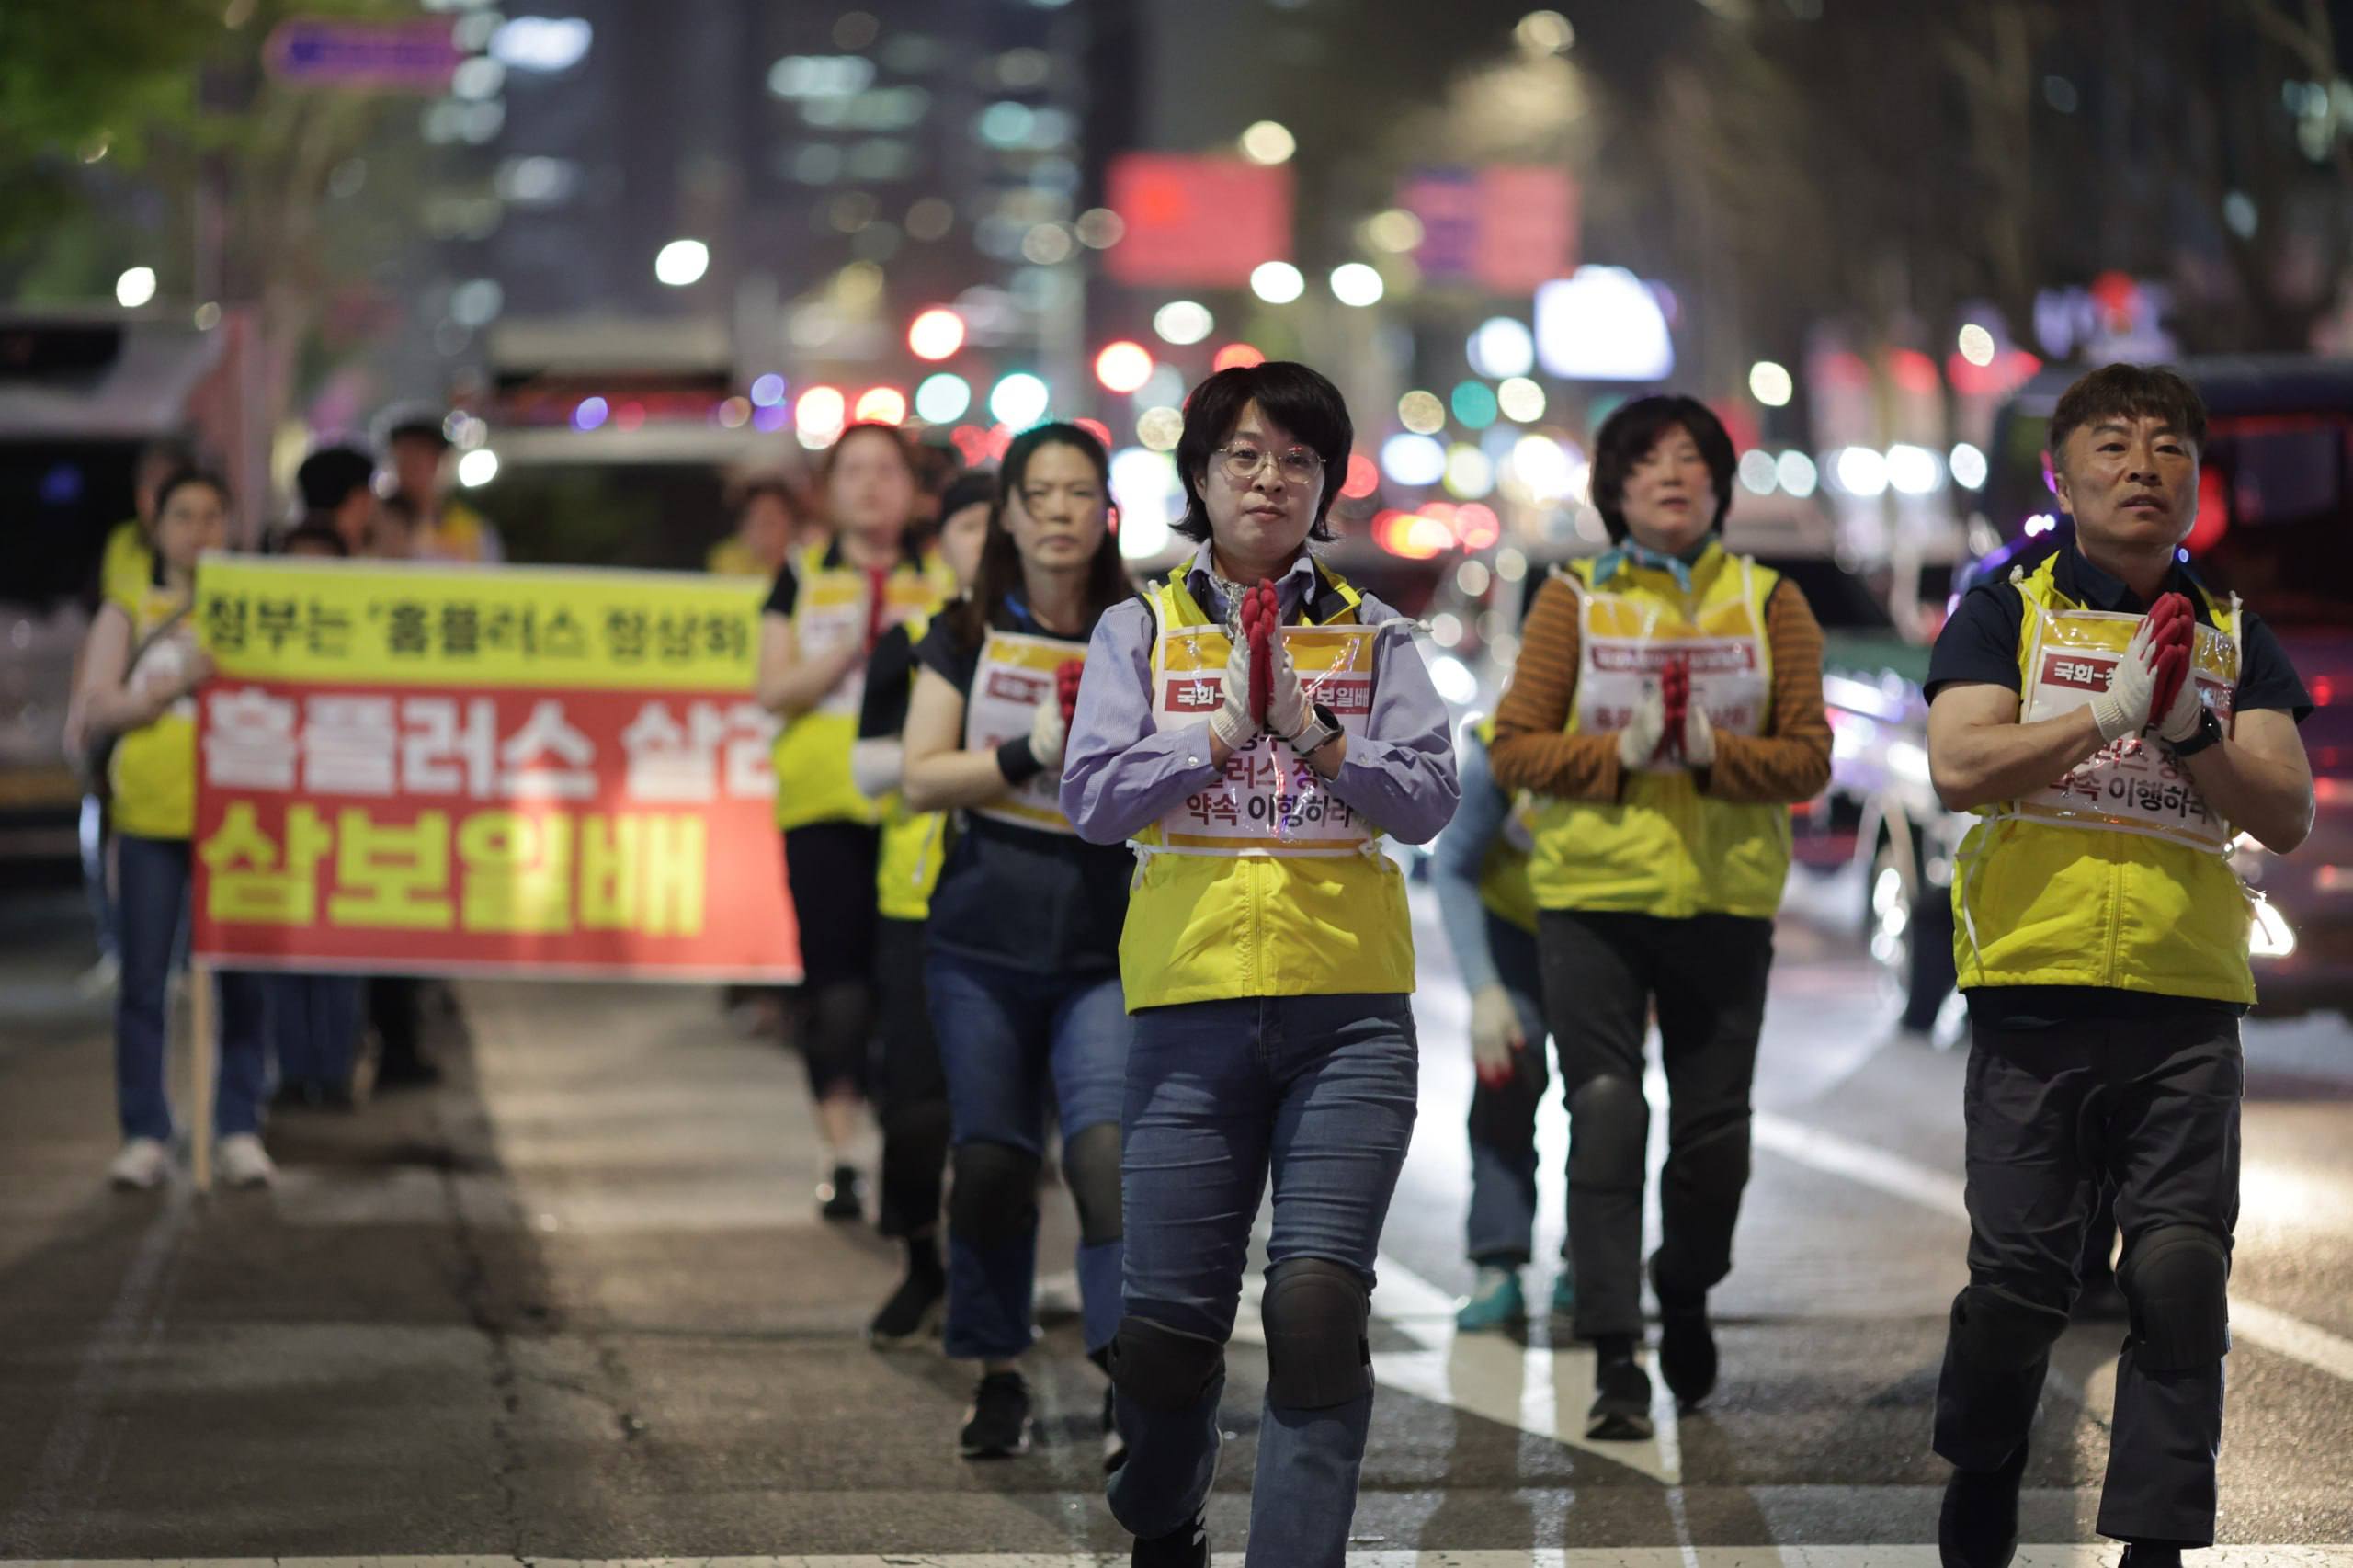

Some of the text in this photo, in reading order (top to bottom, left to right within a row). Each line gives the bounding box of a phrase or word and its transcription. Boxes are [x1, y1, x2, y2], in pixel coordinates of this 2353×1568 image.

[207, 592, 350, 656] 정부는
[204, 689, 599, 799] 홈플러스
[1208, 756, 1285, 790] 러스
[1186, 793, 1353, 829] 약속 이행하라
[199, 802, 706, 937] 삼보일배
